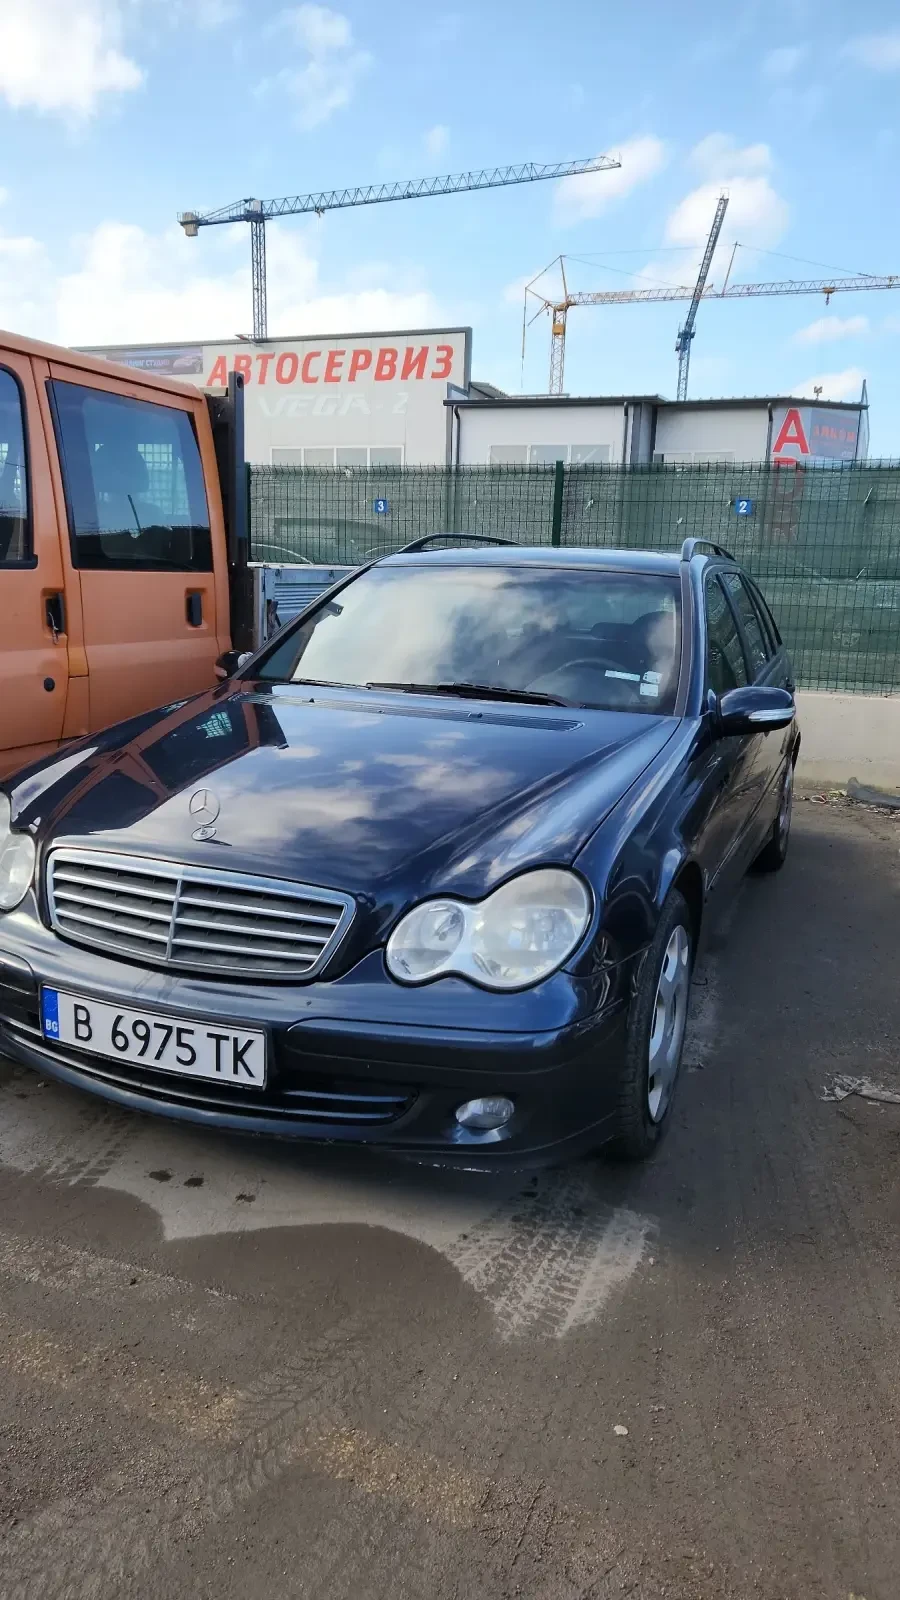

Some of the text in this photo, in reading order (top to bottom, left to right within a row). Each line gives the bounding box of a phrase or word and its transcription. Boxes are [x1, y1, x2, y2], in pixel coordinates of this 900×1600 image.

[206, 345, 454, 387] АВТОСЕРВИЗ
[377, 500, 384, 511] 3
[739, 500, 748, 513] 2
[45, 1018, 58, 1033] BG
[73, 1003, 256, 1079] B 6975 TK
